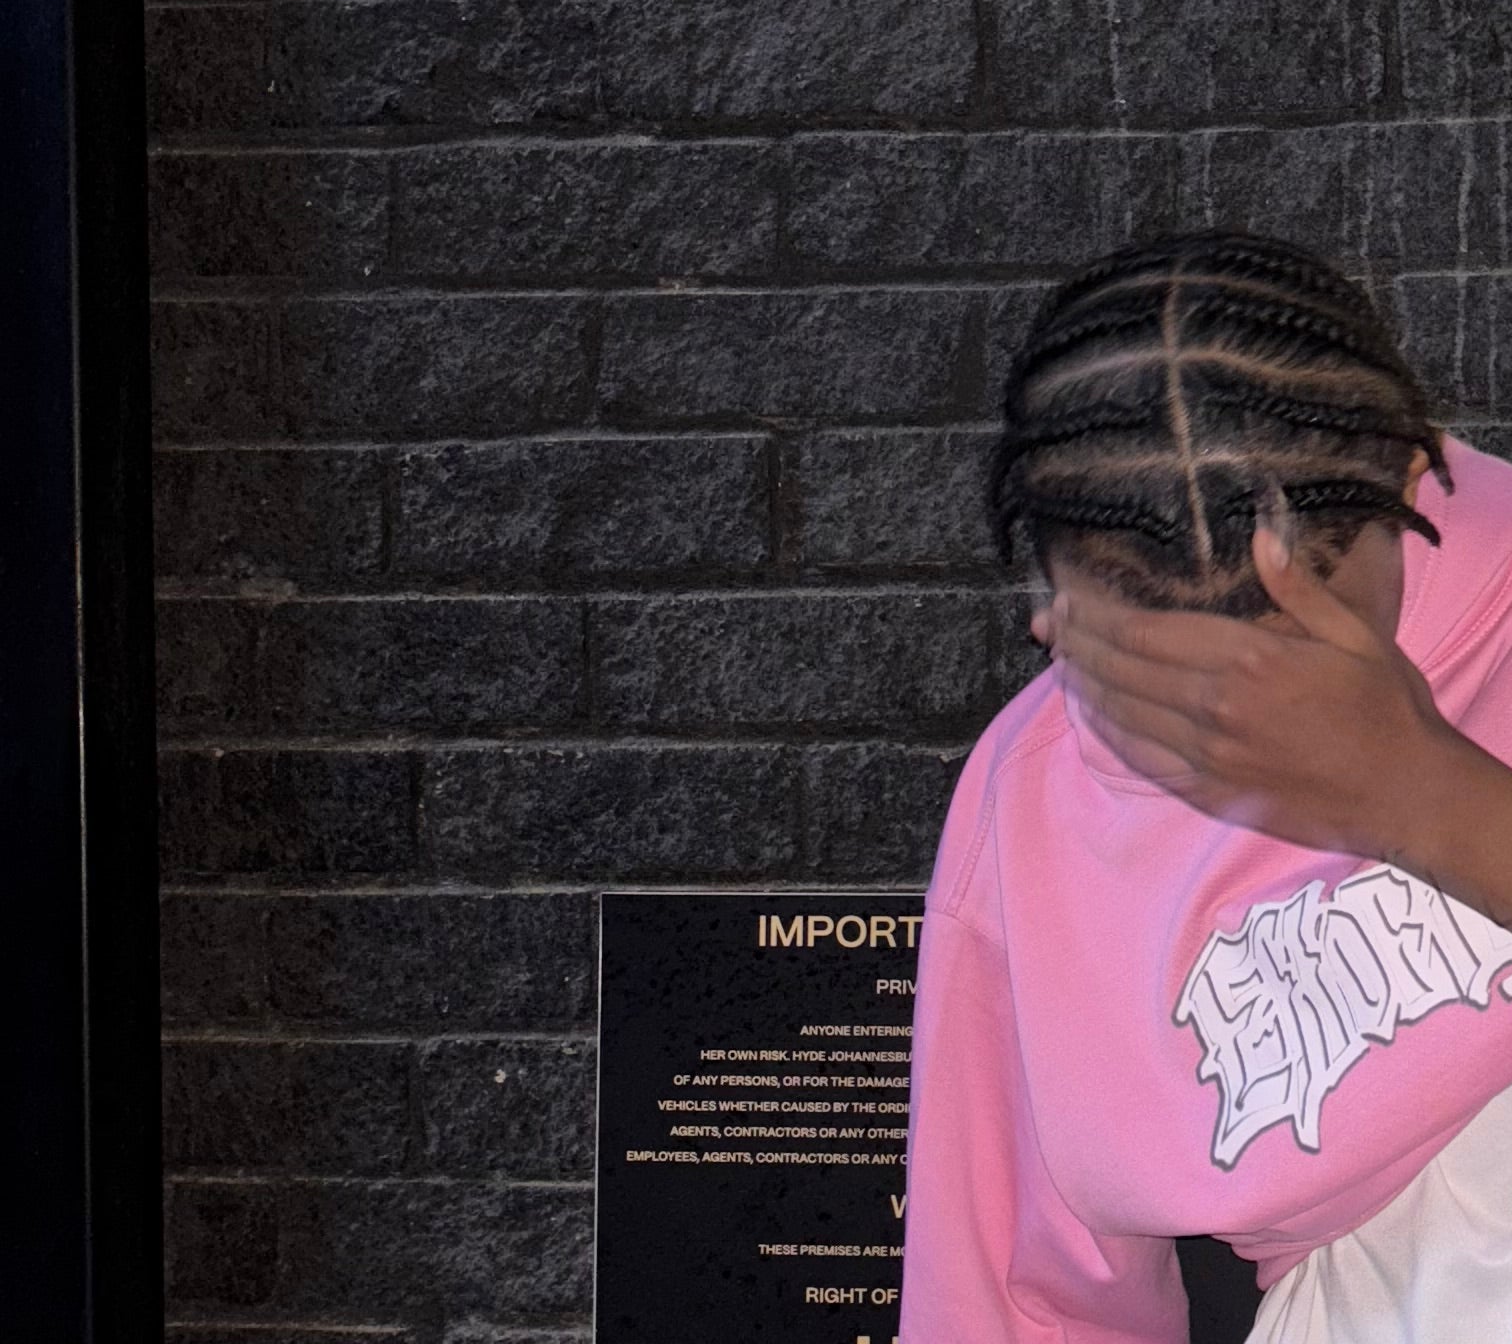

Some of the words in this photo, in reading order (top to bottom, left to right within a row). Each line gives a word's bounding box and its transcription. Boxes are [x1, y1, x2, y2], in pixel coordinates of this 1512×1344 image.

[758, 914, 923, 948] IMPORT
[876, 979, 918, 995] PRIV
[799, 1025, 851, 1037] ANYONE
[853, 1025, 914, 1037] ENTERING
[700, 1049, 727, 1061] HER
[727, 1049, 758, 1061] OWN
[759, 1049, 791, 1061] RISK.
[792, 1050, 826, 1062] HYDE
[827, 1051, 912, 1063] JOHANNESBU
[673, 1074, 691, 1086] OF
[692, 1075, 719, 1086] ANY
[720, 1075, 781, 1089] PERSONS,
[782, 1075, 801, 1087] OR
[802, 1075, 829, 1087] FOR
[830, 1076, 855, 1088] THE
[856, 1076, 910, 1088] DAMAGE
[657, 1099, 717, 1112] VEHICLES
[718, 1100, 780, 1112] WHETHER
[780, 1101, 832, 1113] CAUSED
[832, 1101, 850, 1113] BY
[851, 1102, 876, 1114] THE
[877, 1102, 910, 1114] ORDI
[669, 1125, 722, 1139] AGENTS,
[723, 1126, 818, 1139] CONTRACTORS
[818, 1127, 838, 1139] OR
[838, 1127, 866, 1139] ANY
[867, 1128, 909, 1140] OTHER
[626, 1150, 701, 1164] EMPLOYEES,
[701, 1151, 754, 1165] AGENTS,
[755, 1152, 850, 1165] CONTRACTORS
[850, 1153, 870, 1165] OR
[871, 1153, 898, 1165] ANY
[758, 1243, 798, 1256] THESE
[799, 1244, 862, 1257] PREMISES
[862, 1245, 888, 1257] ARE
[805, 1286, 868, 1304] RIGHT
[870, 1287, 899, 1305] OF
